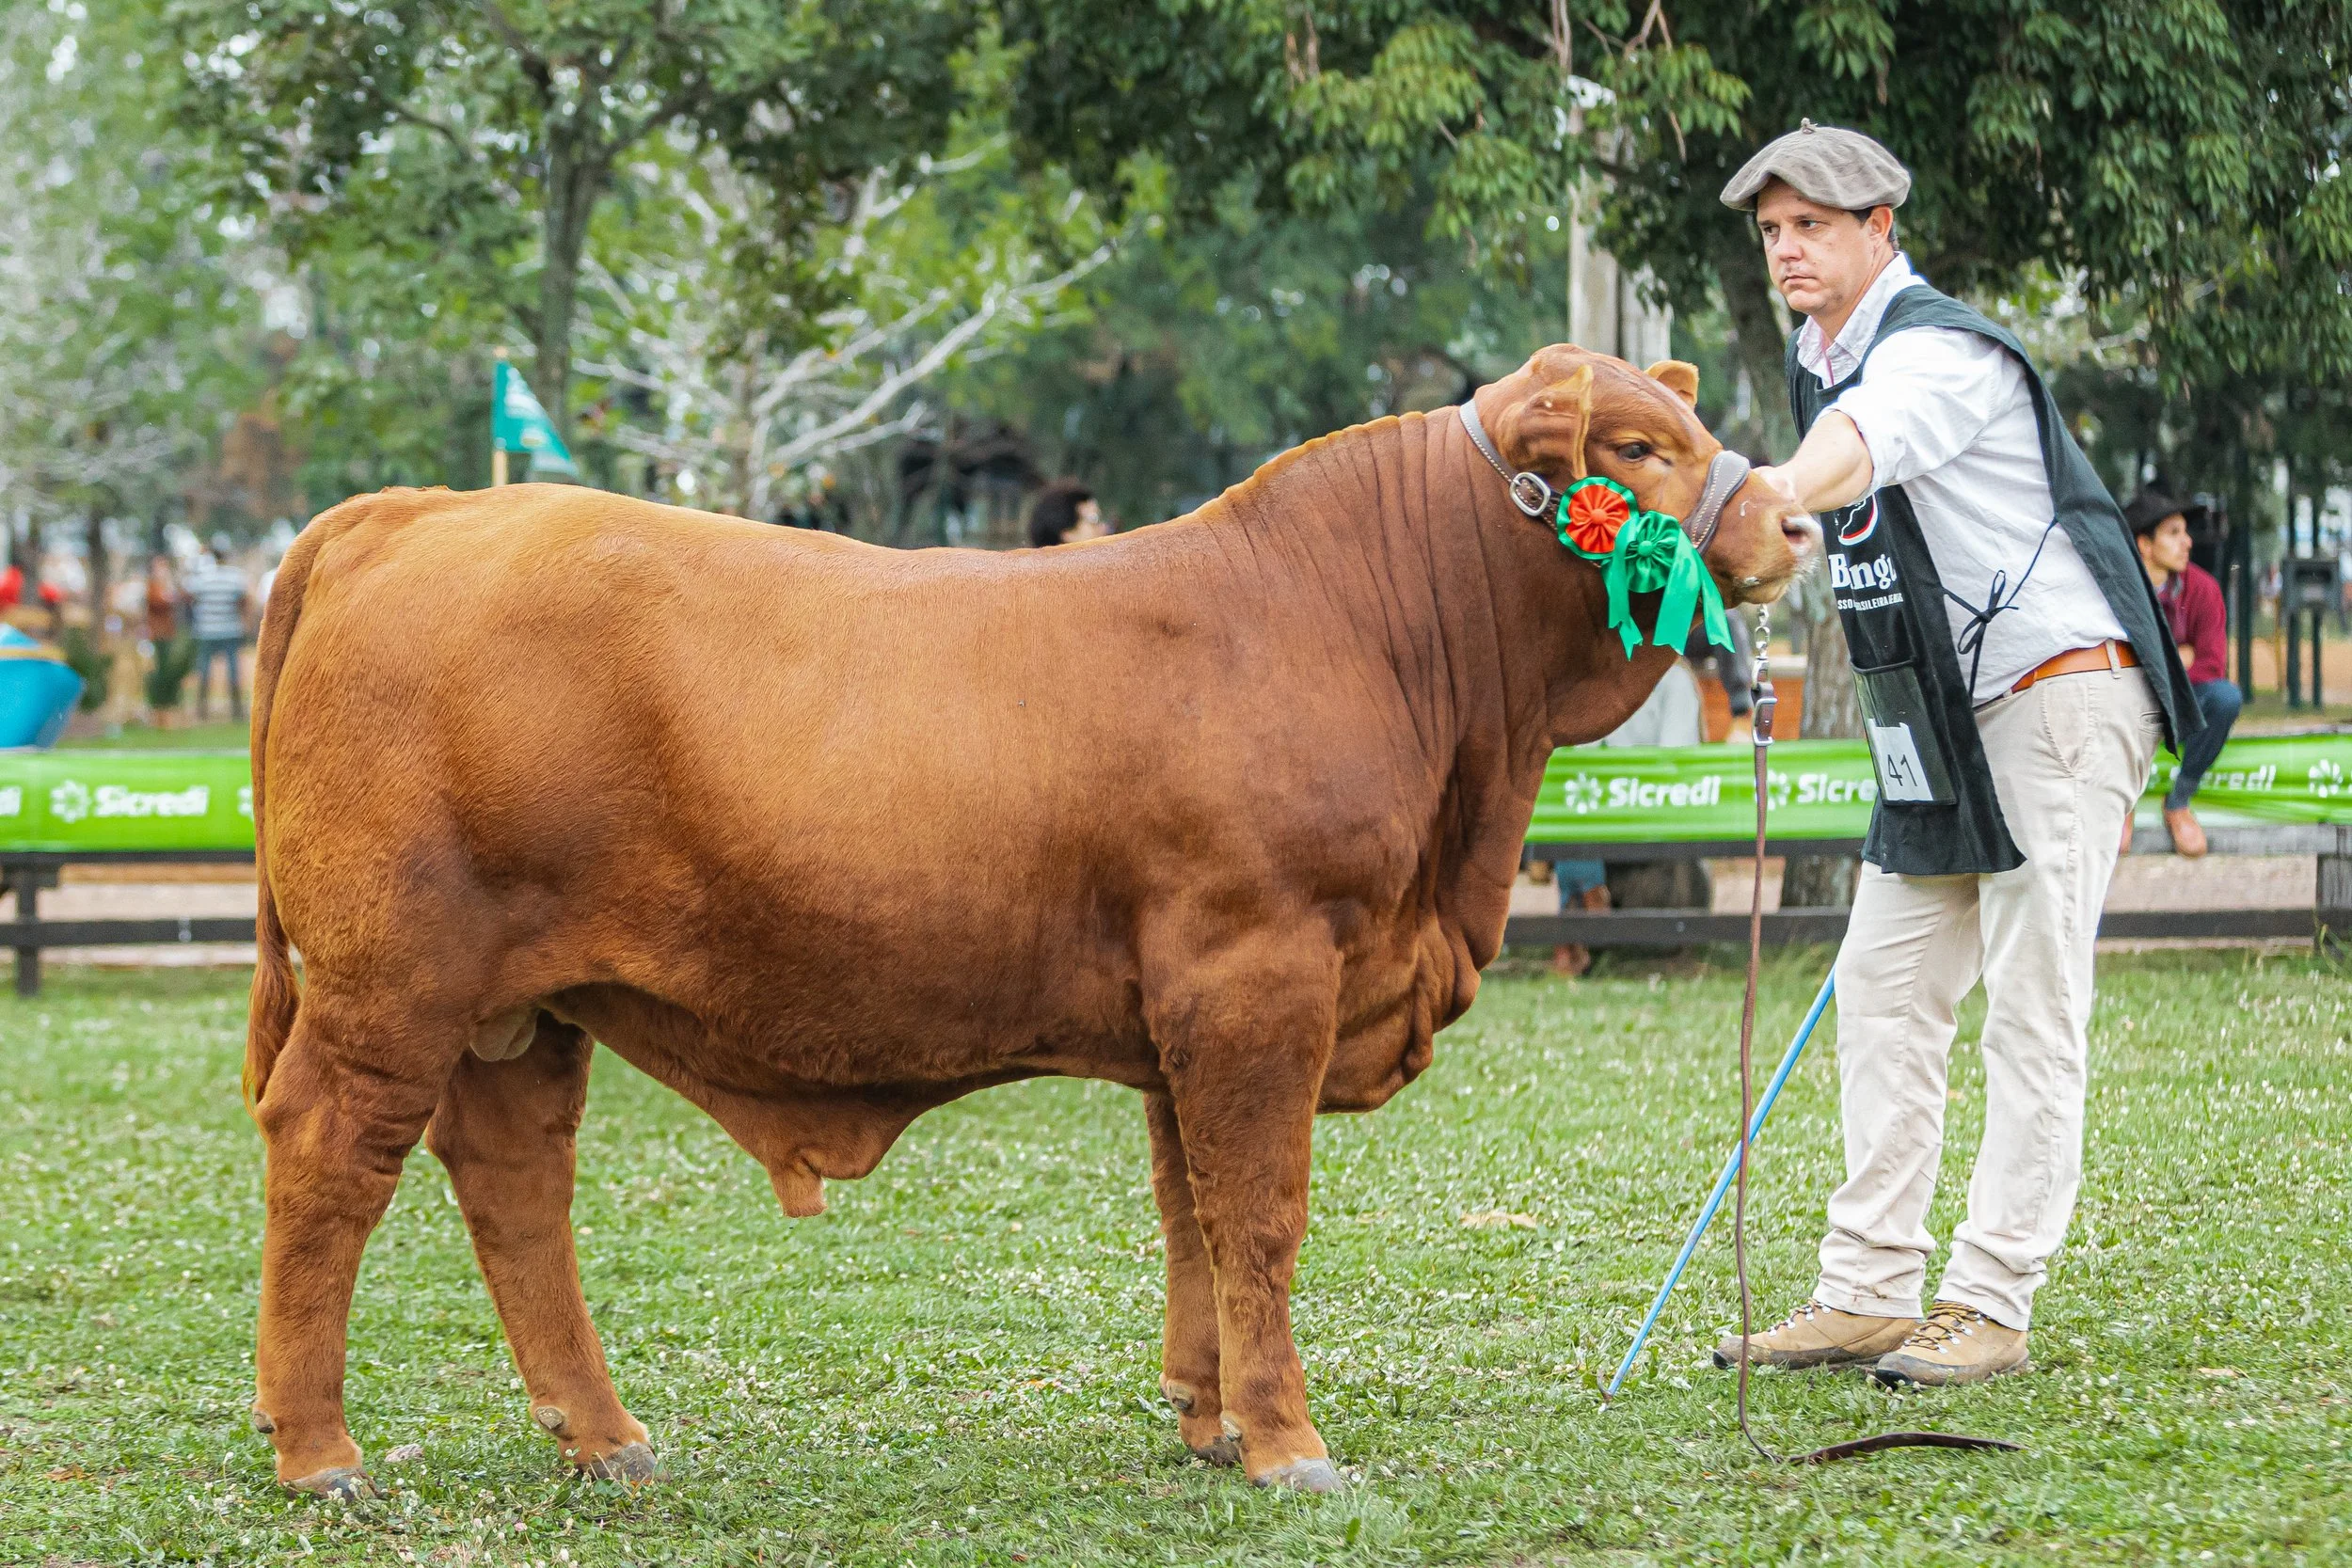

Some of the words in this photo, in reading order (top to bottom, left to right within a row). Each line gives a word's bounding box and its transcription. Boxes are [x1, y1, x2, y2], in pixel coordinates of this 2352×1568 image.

[1884, 754, 1917, 786] 41
[95, 784, 209, 816] Sicredi
[1609, 775, 1721, 807] Sicredi
[1797, 773, 1878, 803] Sicre
